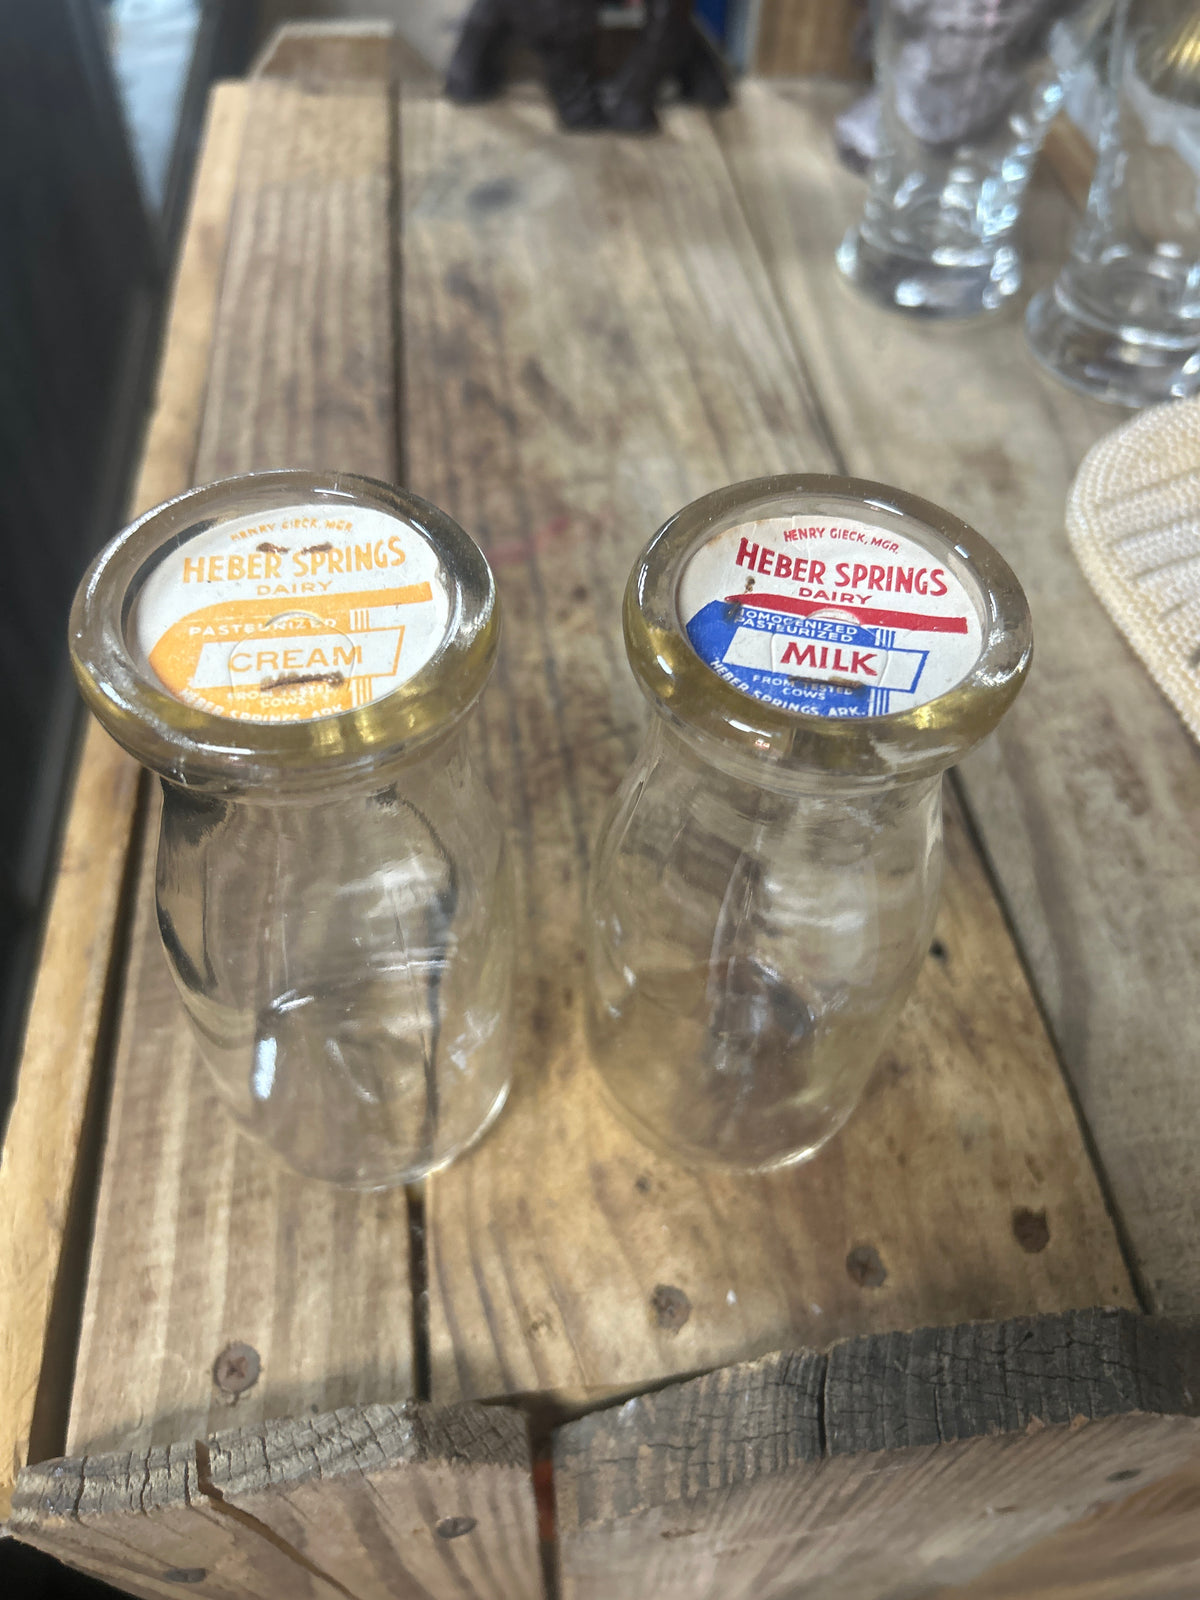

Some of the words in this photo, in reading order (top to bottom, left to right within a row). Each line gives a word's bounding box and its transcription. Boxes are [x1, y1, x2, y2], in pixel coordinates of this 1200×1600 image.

[230, 523, 276, 541] HENRY
[784, 527, 825, 542] HENRY
[829, 528, 868, 545] GIECK,
[871, 538, 899, 554] MGR.
[183, 552, 282, 583] HEBER
[292, 536, 406, 578] SPRINGS
[735, 537, 826, 585] HEBER
[834, 562, 948, 597] SPRINGS
[257, 580, 333, 596] DAIRY
[799, 587, 872, 605] DAIRY
[735, 616, 853, 643] PASTEURIZED
[230, 645, 363, 673] CREAM
[780, 641, 878, 677] MILK
[710, 658, 749, 692] HEBER
[828, 706, 866, 718] ARK.
[752, 674, 796, 688] FROM
[803, 681, 853, 696] TESTED
[782, 687, 826, 701] COWS
[260, 697, 307, 708] COWS
